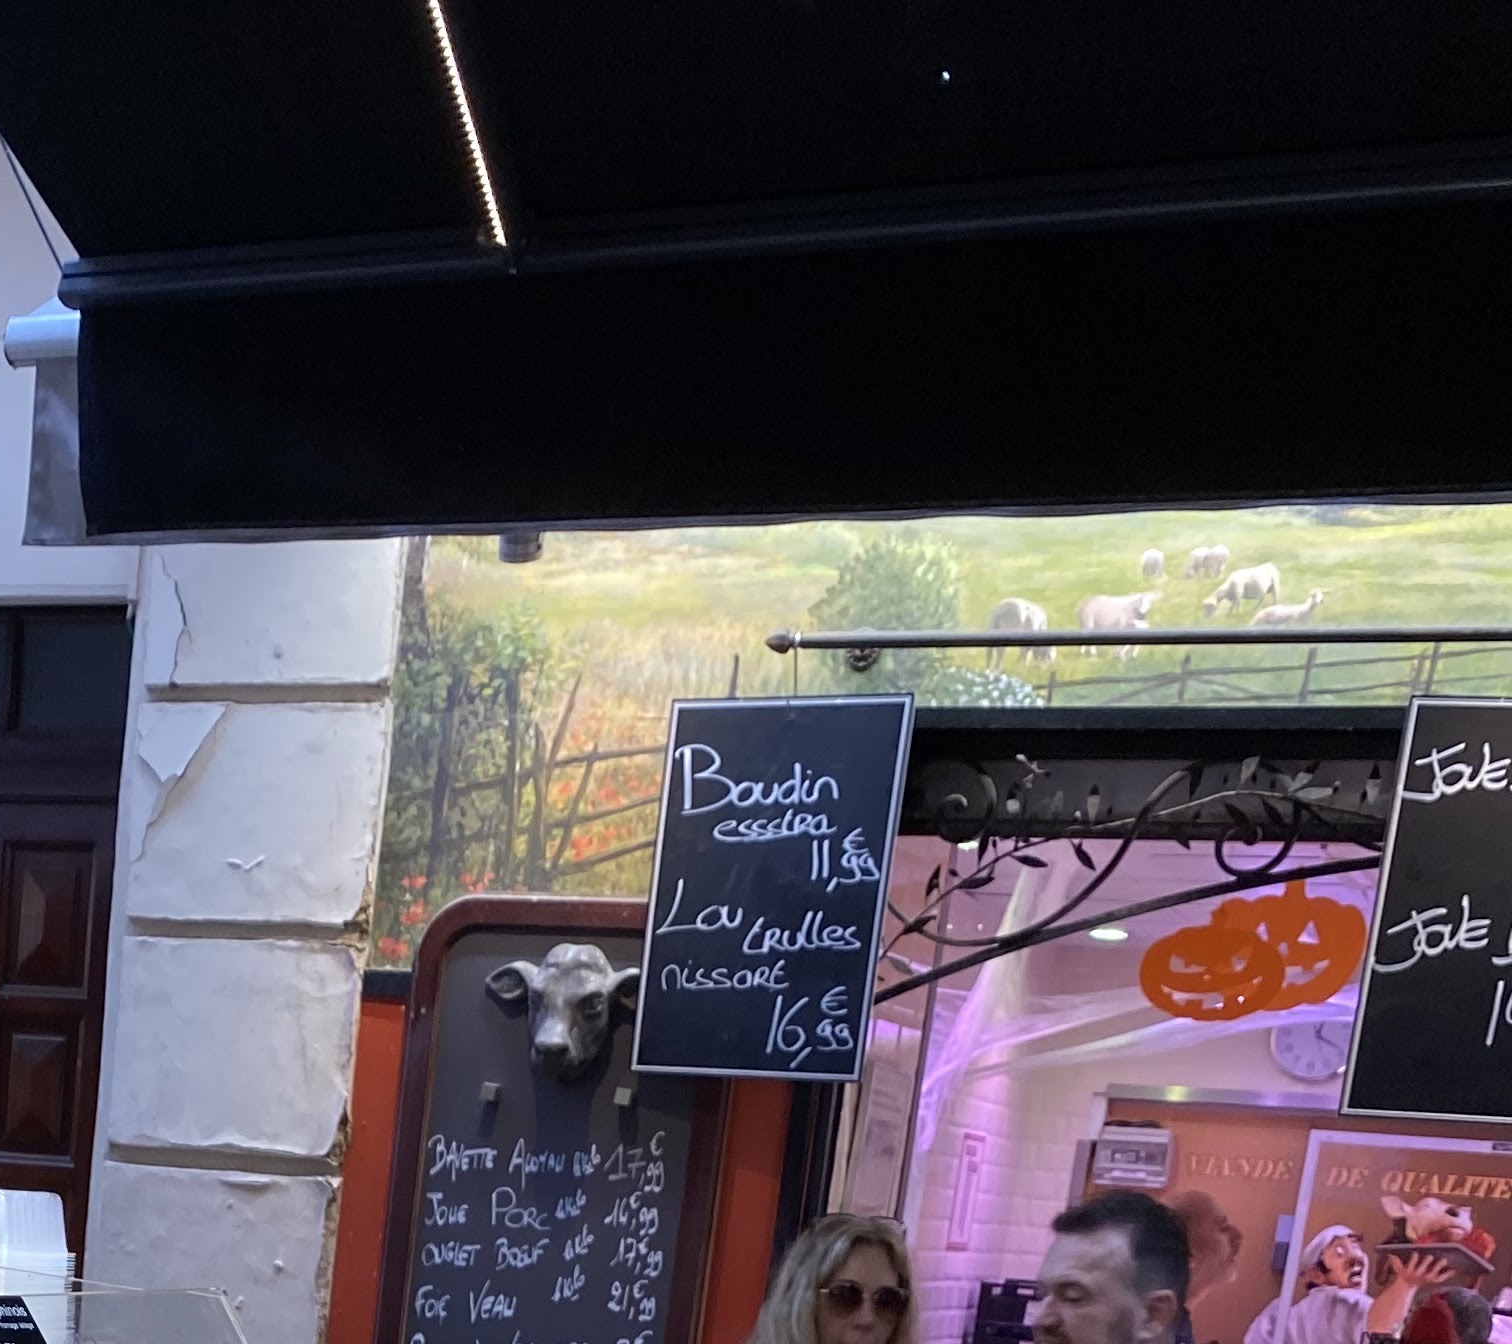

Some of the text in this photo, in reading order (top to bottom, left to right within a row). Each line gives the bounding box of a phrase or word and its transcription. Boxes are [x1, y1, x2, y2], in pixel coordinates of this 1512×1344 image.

[674, 741, 840, 815] Boudin
[1188, 1153, 1512, 1200] VIANDE DE QUALITE
